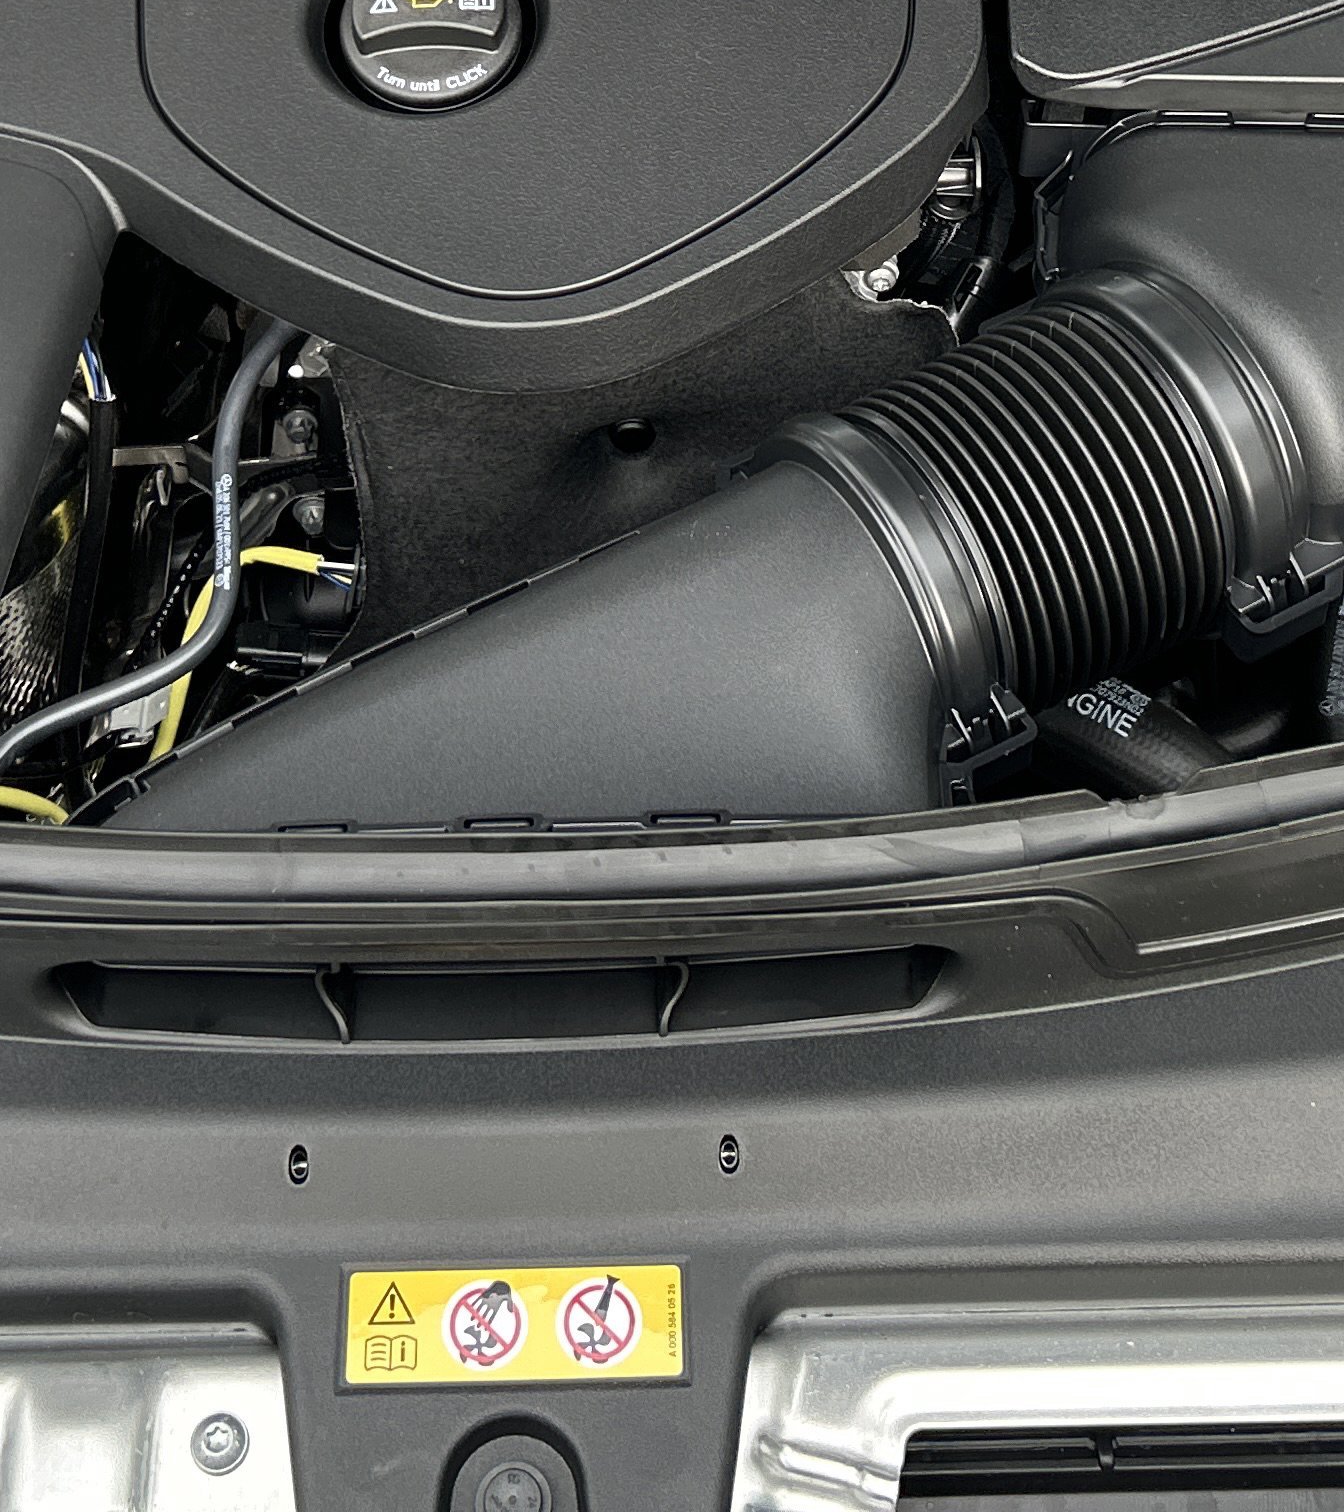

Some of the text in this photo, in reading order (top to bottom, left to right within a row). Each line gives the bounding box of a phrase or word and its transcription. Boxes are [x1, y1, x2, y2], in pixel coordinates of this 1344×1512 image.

[376, 63, 488, 92] Turn until CLICK
